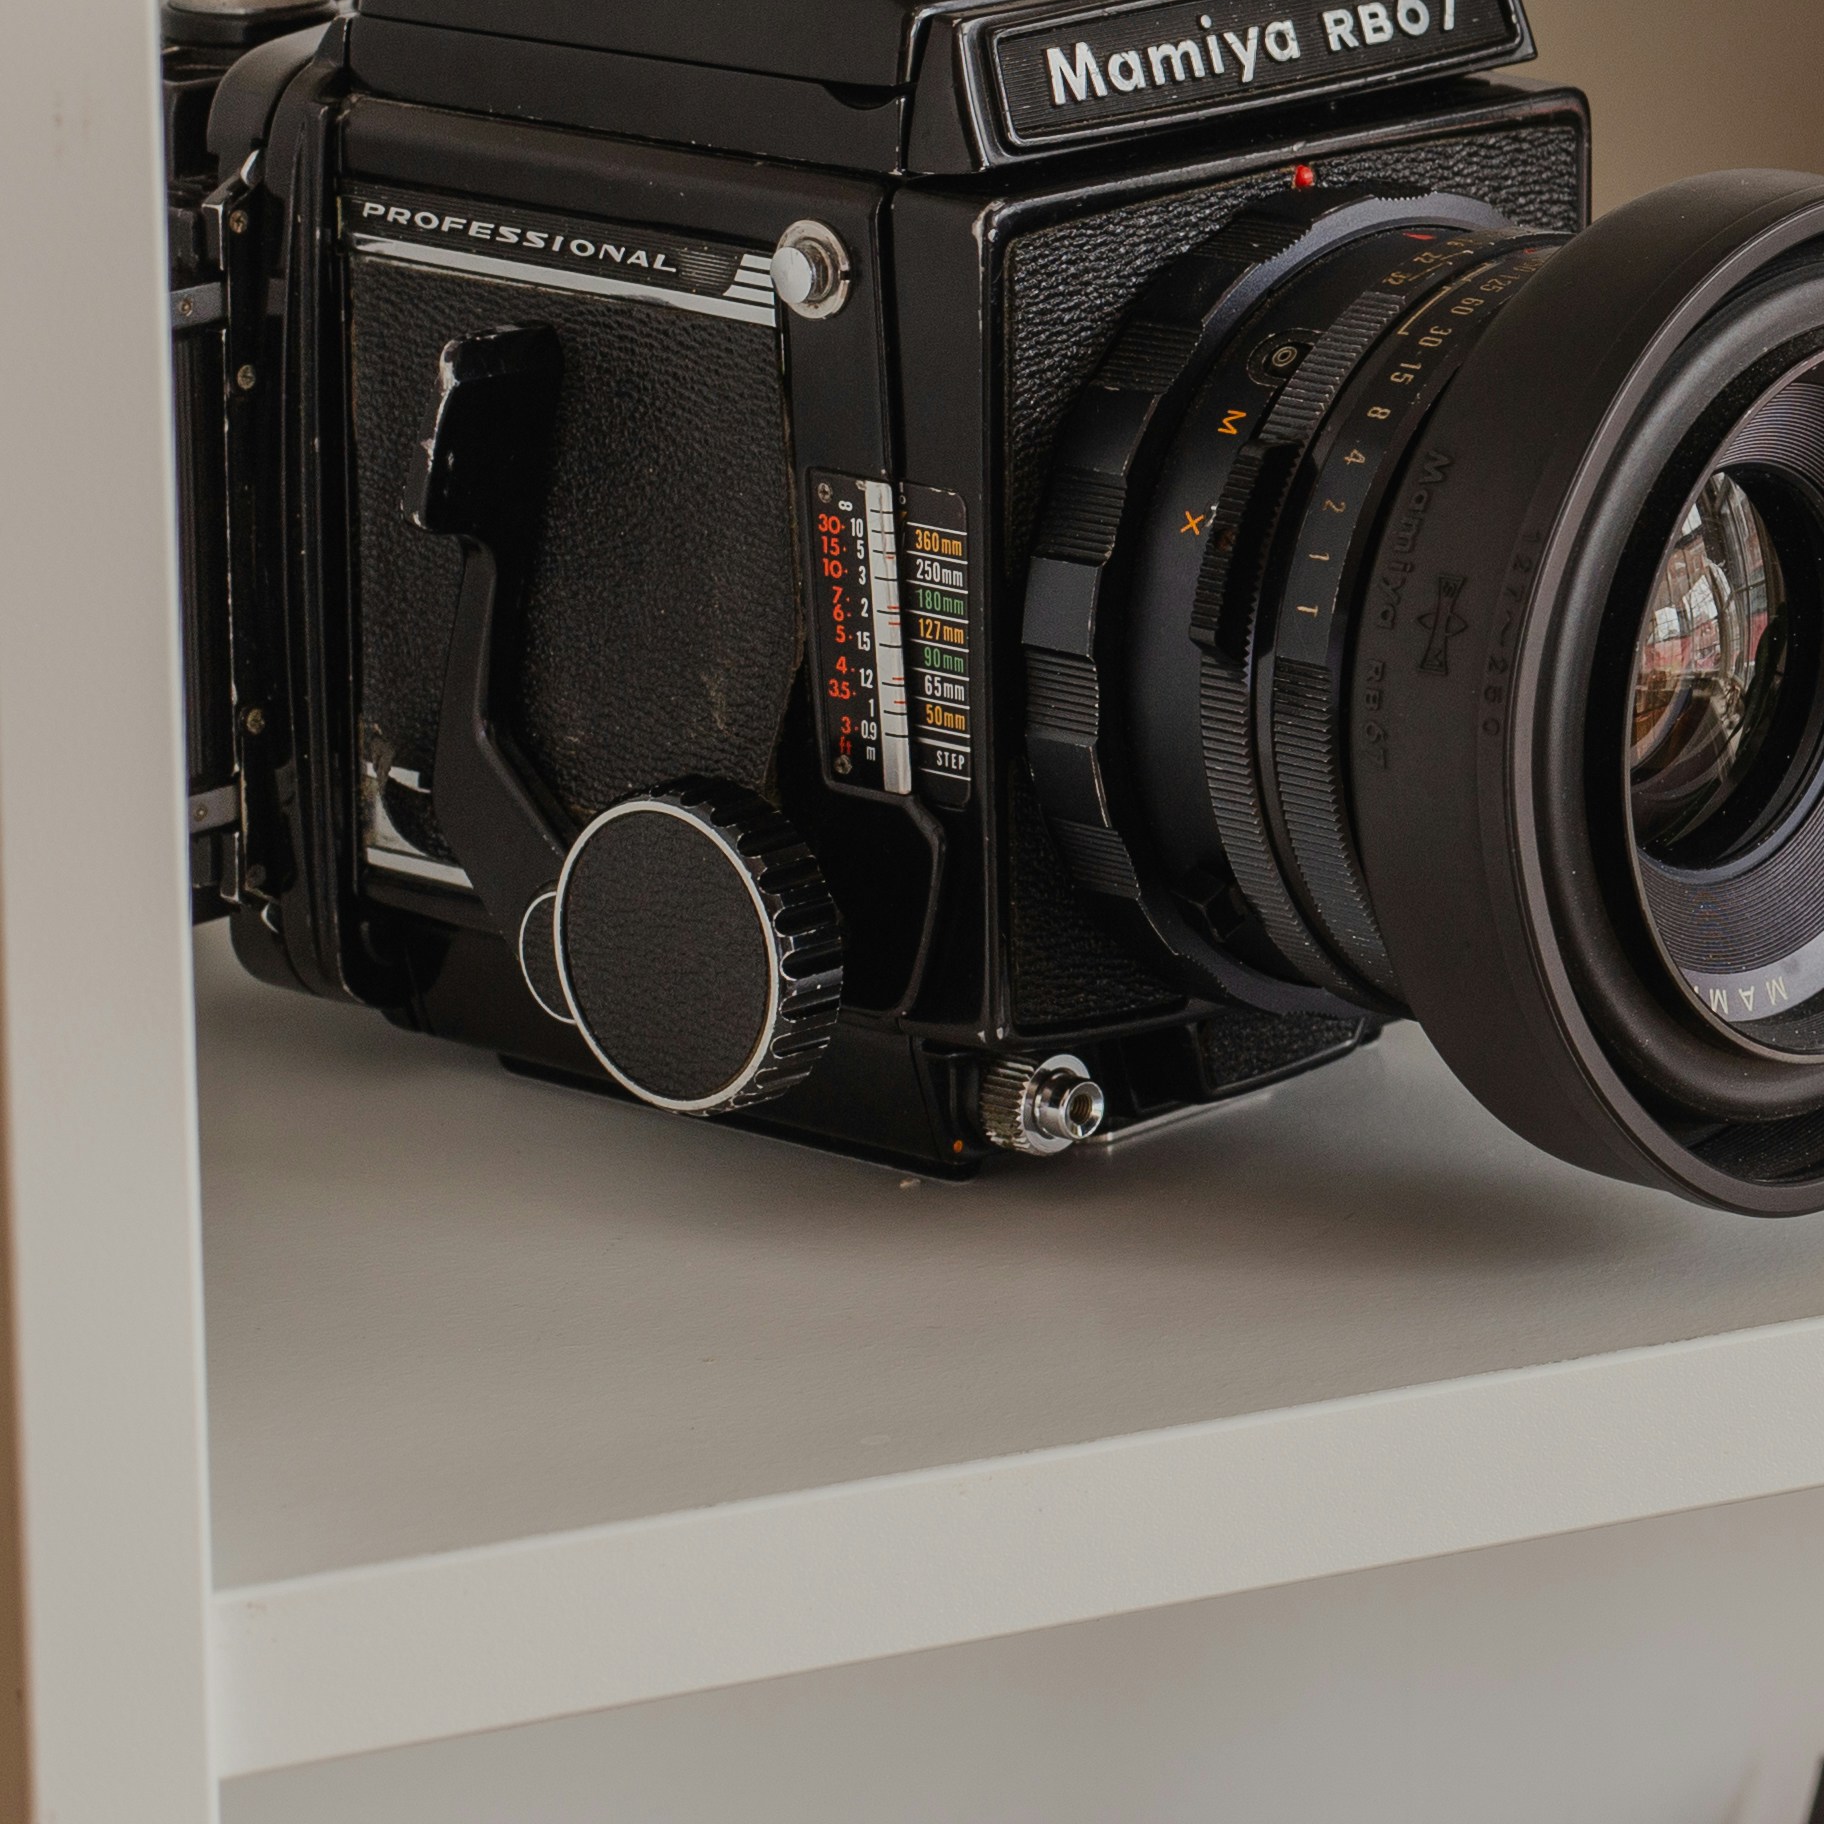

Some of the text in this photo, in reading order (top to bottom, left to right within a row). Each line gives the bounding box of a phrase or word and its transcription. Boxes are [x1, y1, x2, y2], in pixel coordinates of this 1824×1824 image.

[1047, 14, 1300, 105] Mamiya
[360, 201, 678, 274] PROFESSIONAL
[1480, 274, 1521, 293] 125
[1451, 297, 1485, 316] 60
[1418, 326, 1453, 348] 30
[1390, 361, 1422, 385] 15
[1217, 409, 1247, 435] M
[1367, 406, 1392, 420] 8
[1343, 448, 1366, 466] 4
[1323, 498, 1347, 514] 2
[817, 513, 841, 533] 30
[850, 517, 864, 538] 10
[1179, 510, 1205, 536] X
[822, 536, 839, 557] 15
[856, 540, 865, 559] 5
[915, 529, 962, 557] 360mm
[1308, 551, 1331, 562] 1
[823, 558, 842, 579] 10
[858, 565, 866, 585] 3
[916, 558, 963, 587] 250mm
[832, 586, 843, 604] 7
[917, 589, 964, 615] 180mm
[833, 604, 845, 622] 6
[861, 598, 869, 618] 2
[1296, 604, 1318, 619] T
[1361, 449, 1454, 770] Mamiya RB67
[835, 625, 846, 643] 5
[919, 618, 964, 645] 127mm
[836, 656, 847, 675] 4
[924, 647, 964, 673] 90mm
[924, 675, 965, 702] 65mm
[868, 699, 874, 717] 1
[926, 704, 965, 731] 50mm
[841, 716, 852, 735] 3
[866, 745, 876, 761] m
[936, 750, 965, 770] STEP
